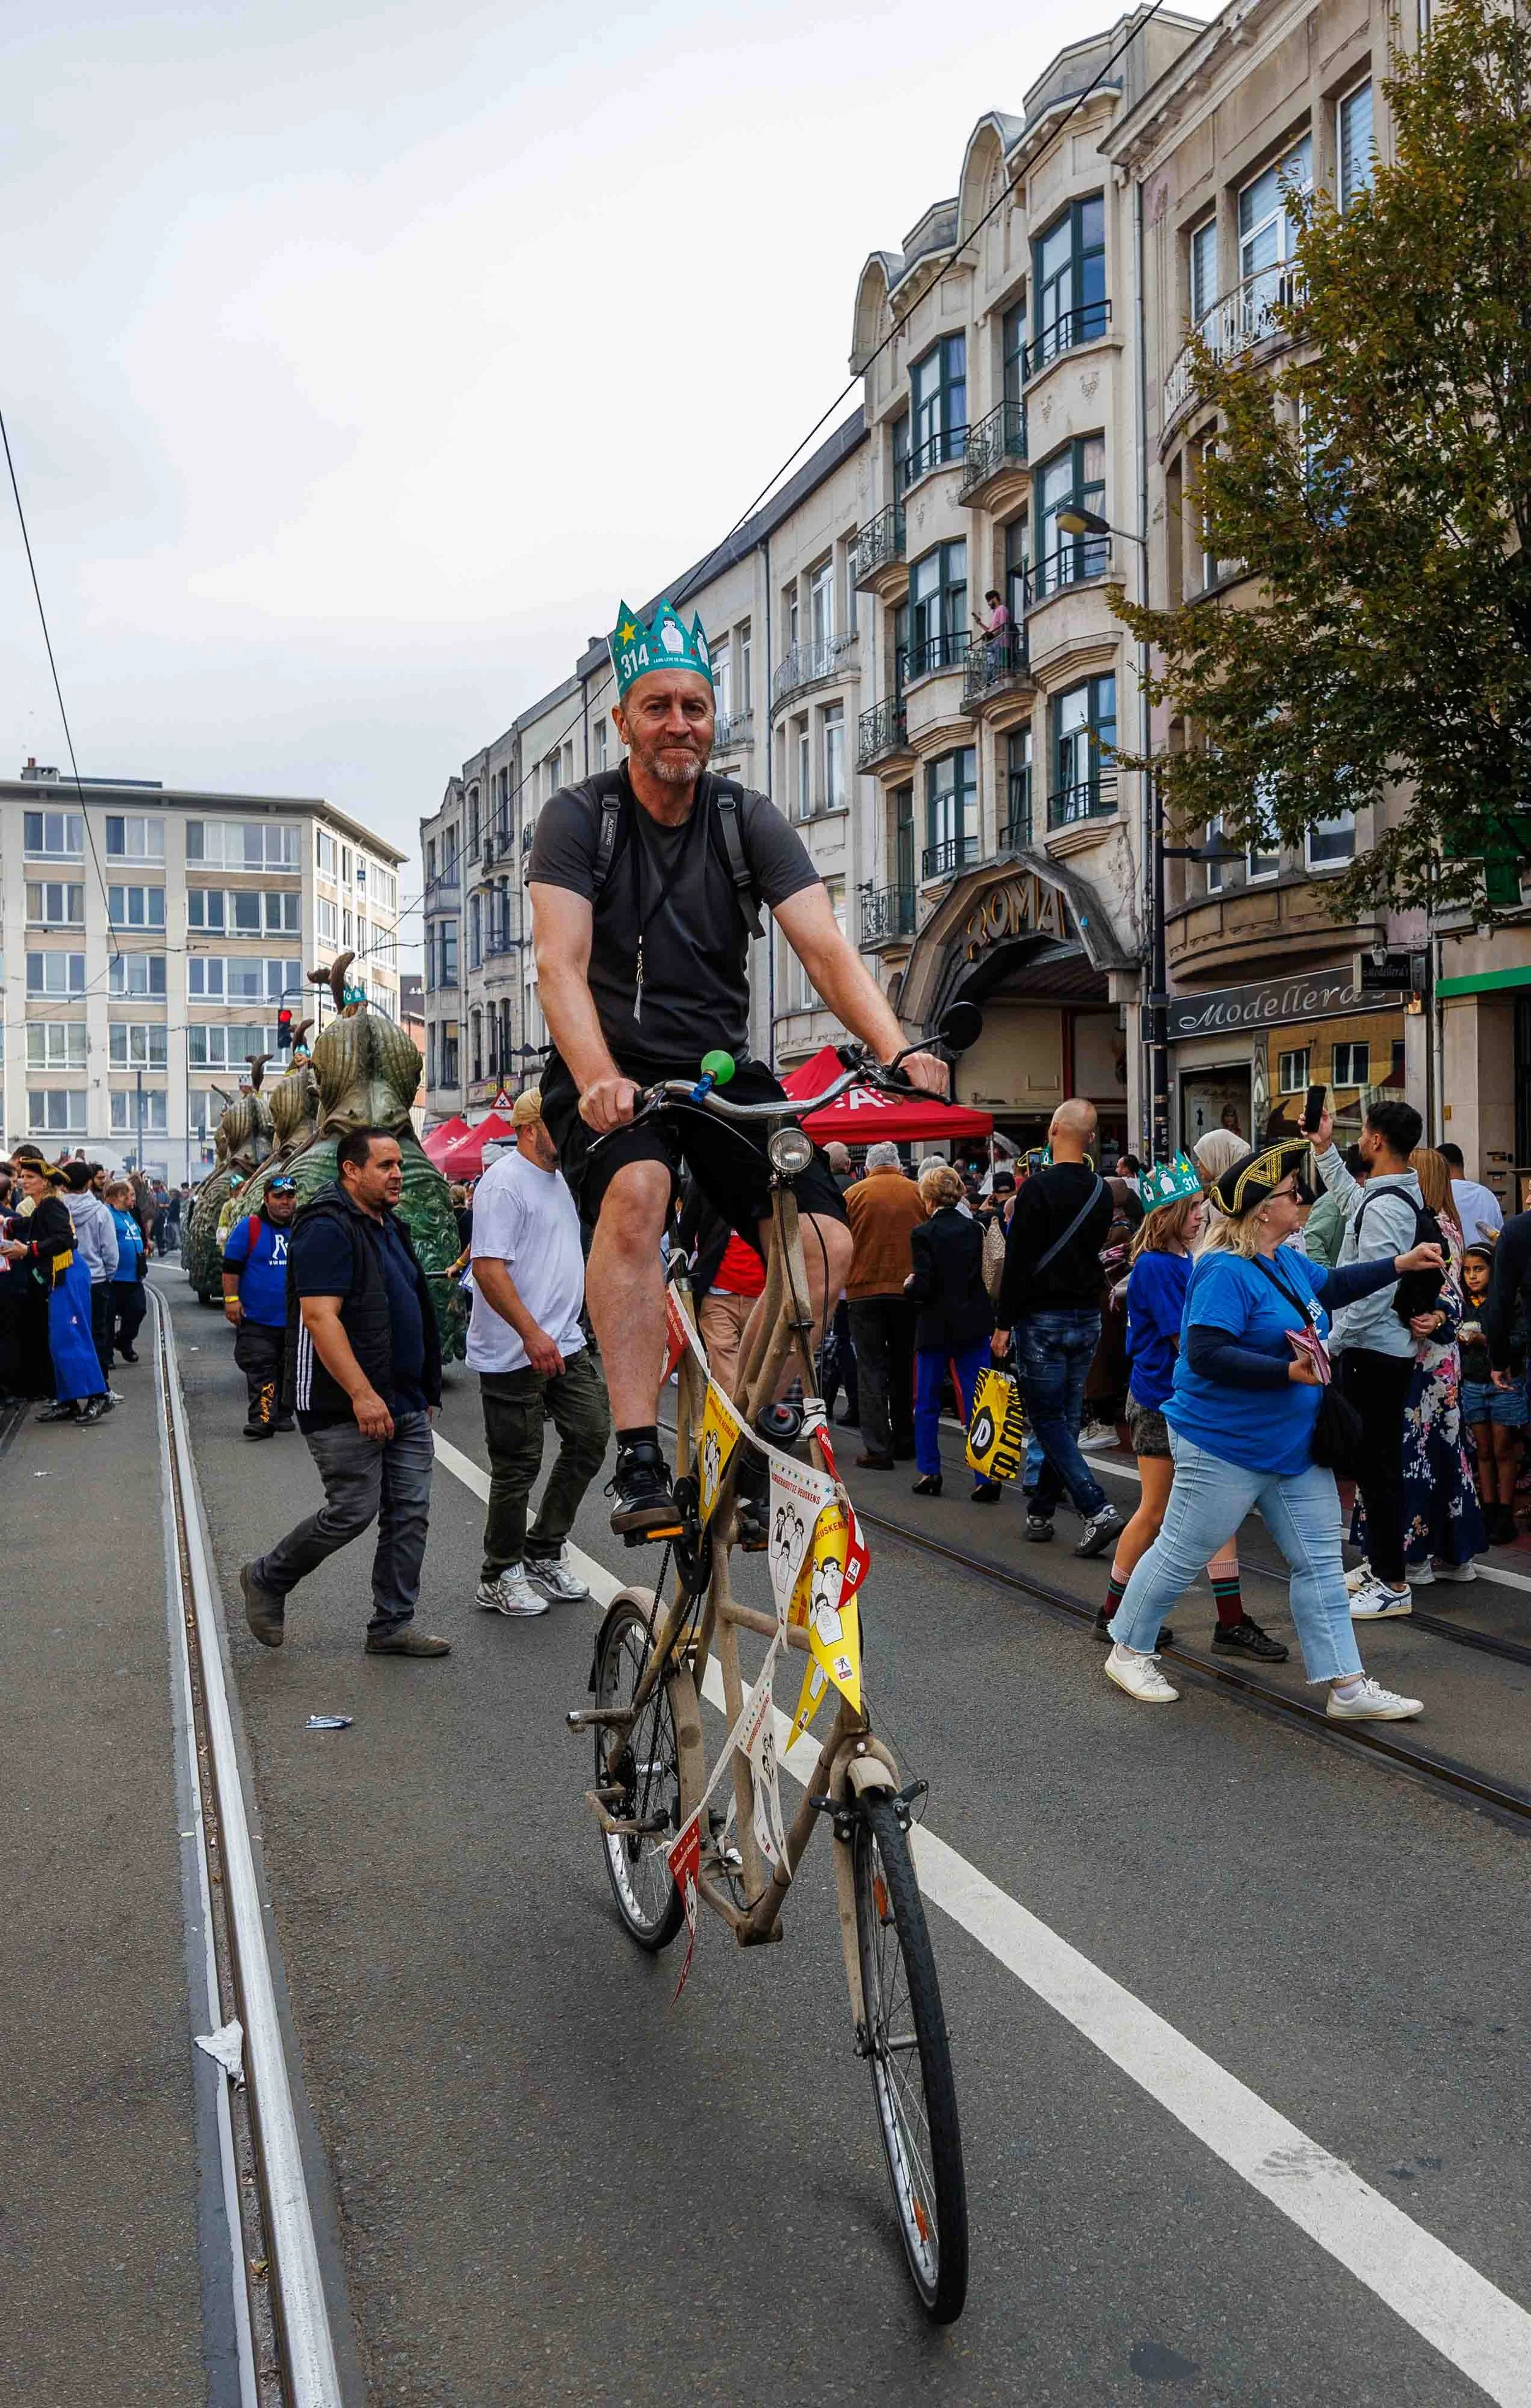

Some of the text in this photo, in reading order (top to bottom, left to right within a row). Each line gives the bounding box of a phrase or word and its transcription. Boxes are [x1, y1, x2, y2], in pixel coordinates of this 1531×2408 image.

[621, 643, 649, 679] 314
[962, 875, 1066, 961] ROMA
[1179, 983, 1386, 1029] Modellera
[1182, 1175, 1200, 1191] 314
[797, 1487, 821, 1505] REUSKENS
